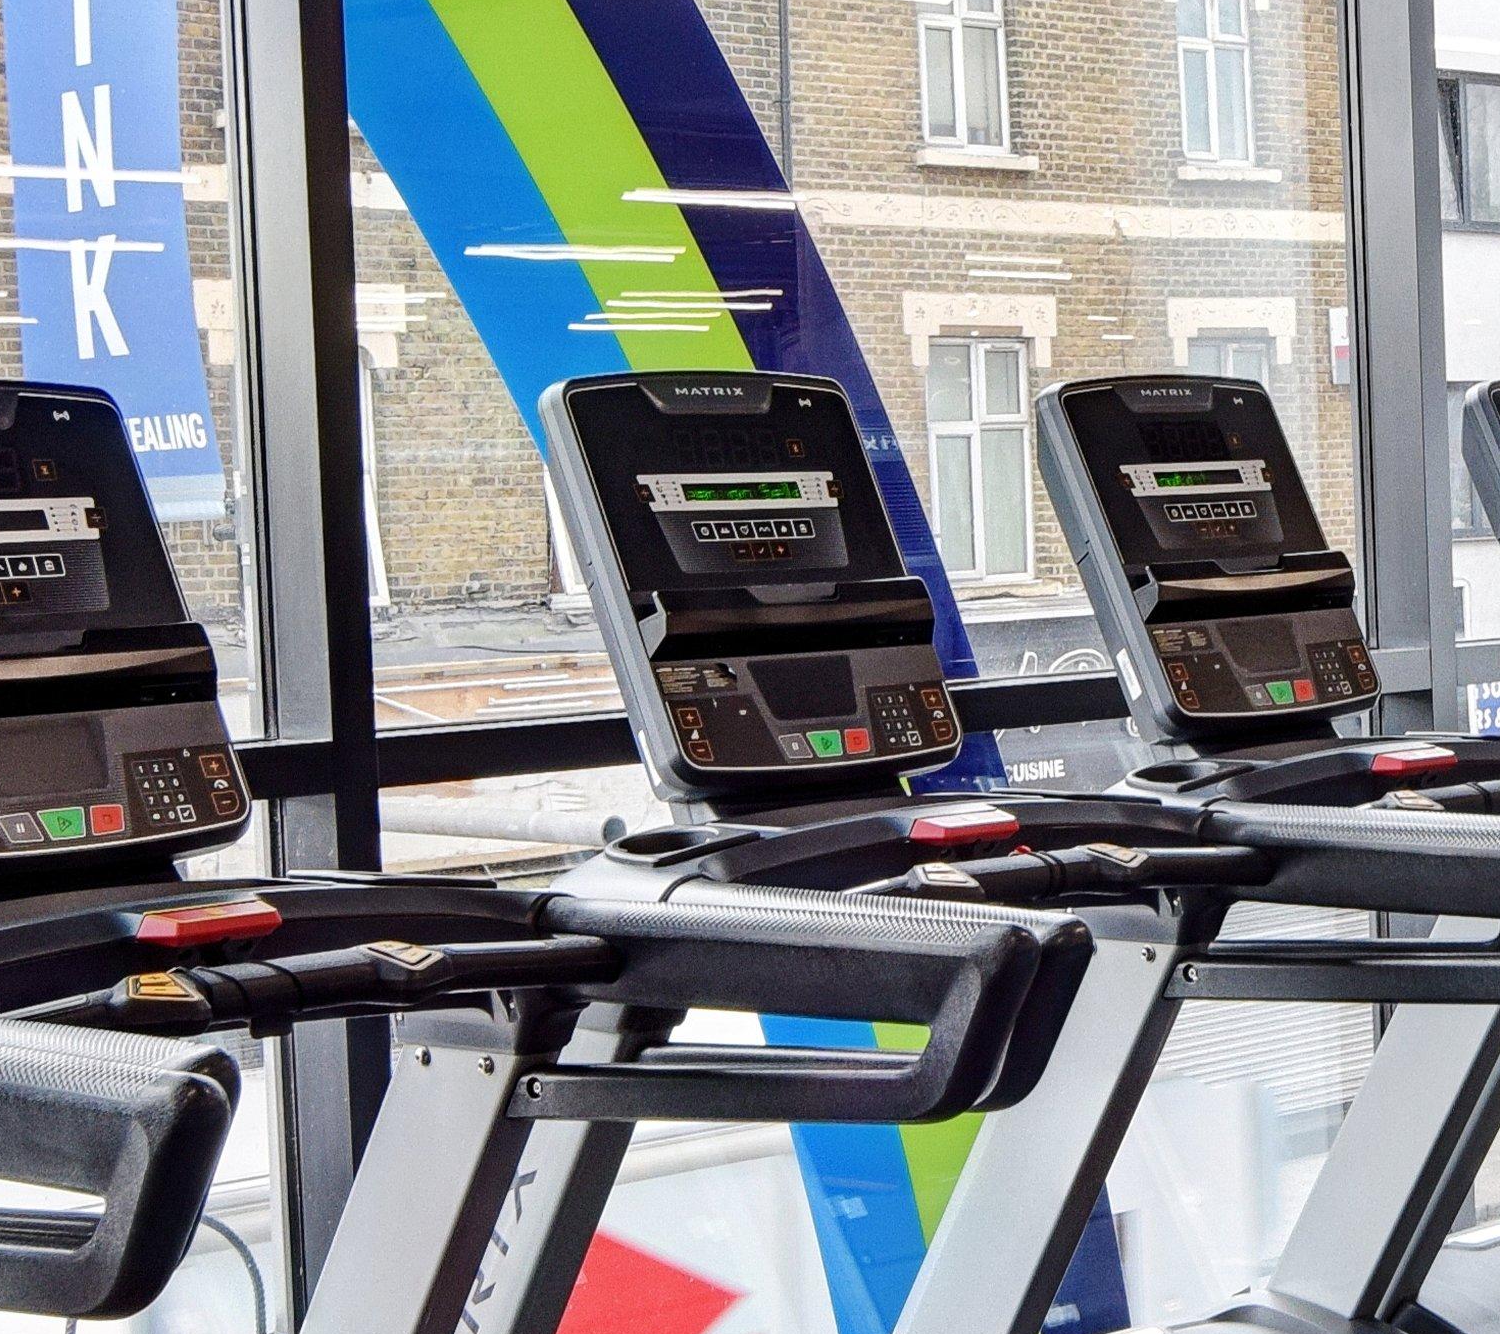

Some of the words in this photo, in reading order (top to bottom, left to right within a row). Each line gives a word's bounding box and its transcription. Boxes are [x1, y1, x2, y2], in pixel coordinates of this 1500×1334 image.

[674, 387, 744, 396] MATRIX
[1140, 388, 1192, 397] MATRIX
[125, 413, 208, 453] EALING
